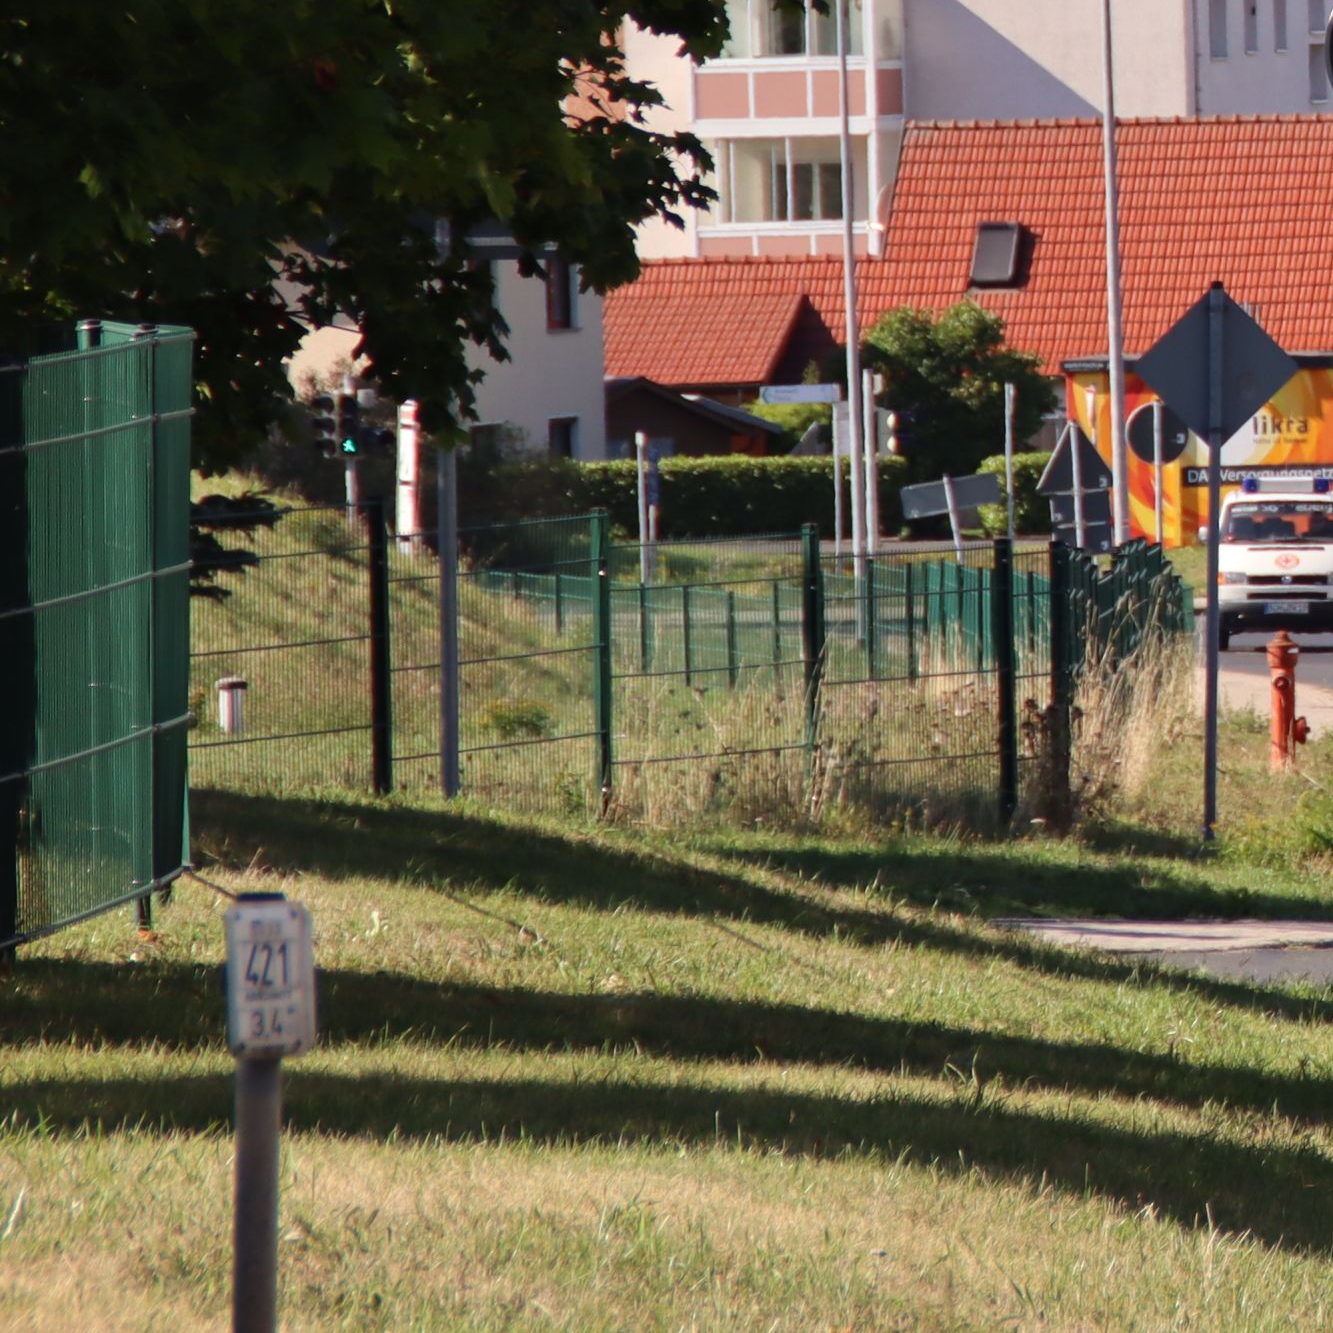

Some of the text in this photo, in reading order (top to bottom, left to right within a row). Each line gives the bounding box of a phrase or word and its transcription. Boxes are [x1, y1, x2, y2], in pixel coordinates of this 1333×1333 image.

[1252, 415, 1309, 435] likra
[1187, 469, 1209, 483] DA
[245, 941, 290, 986] 421
